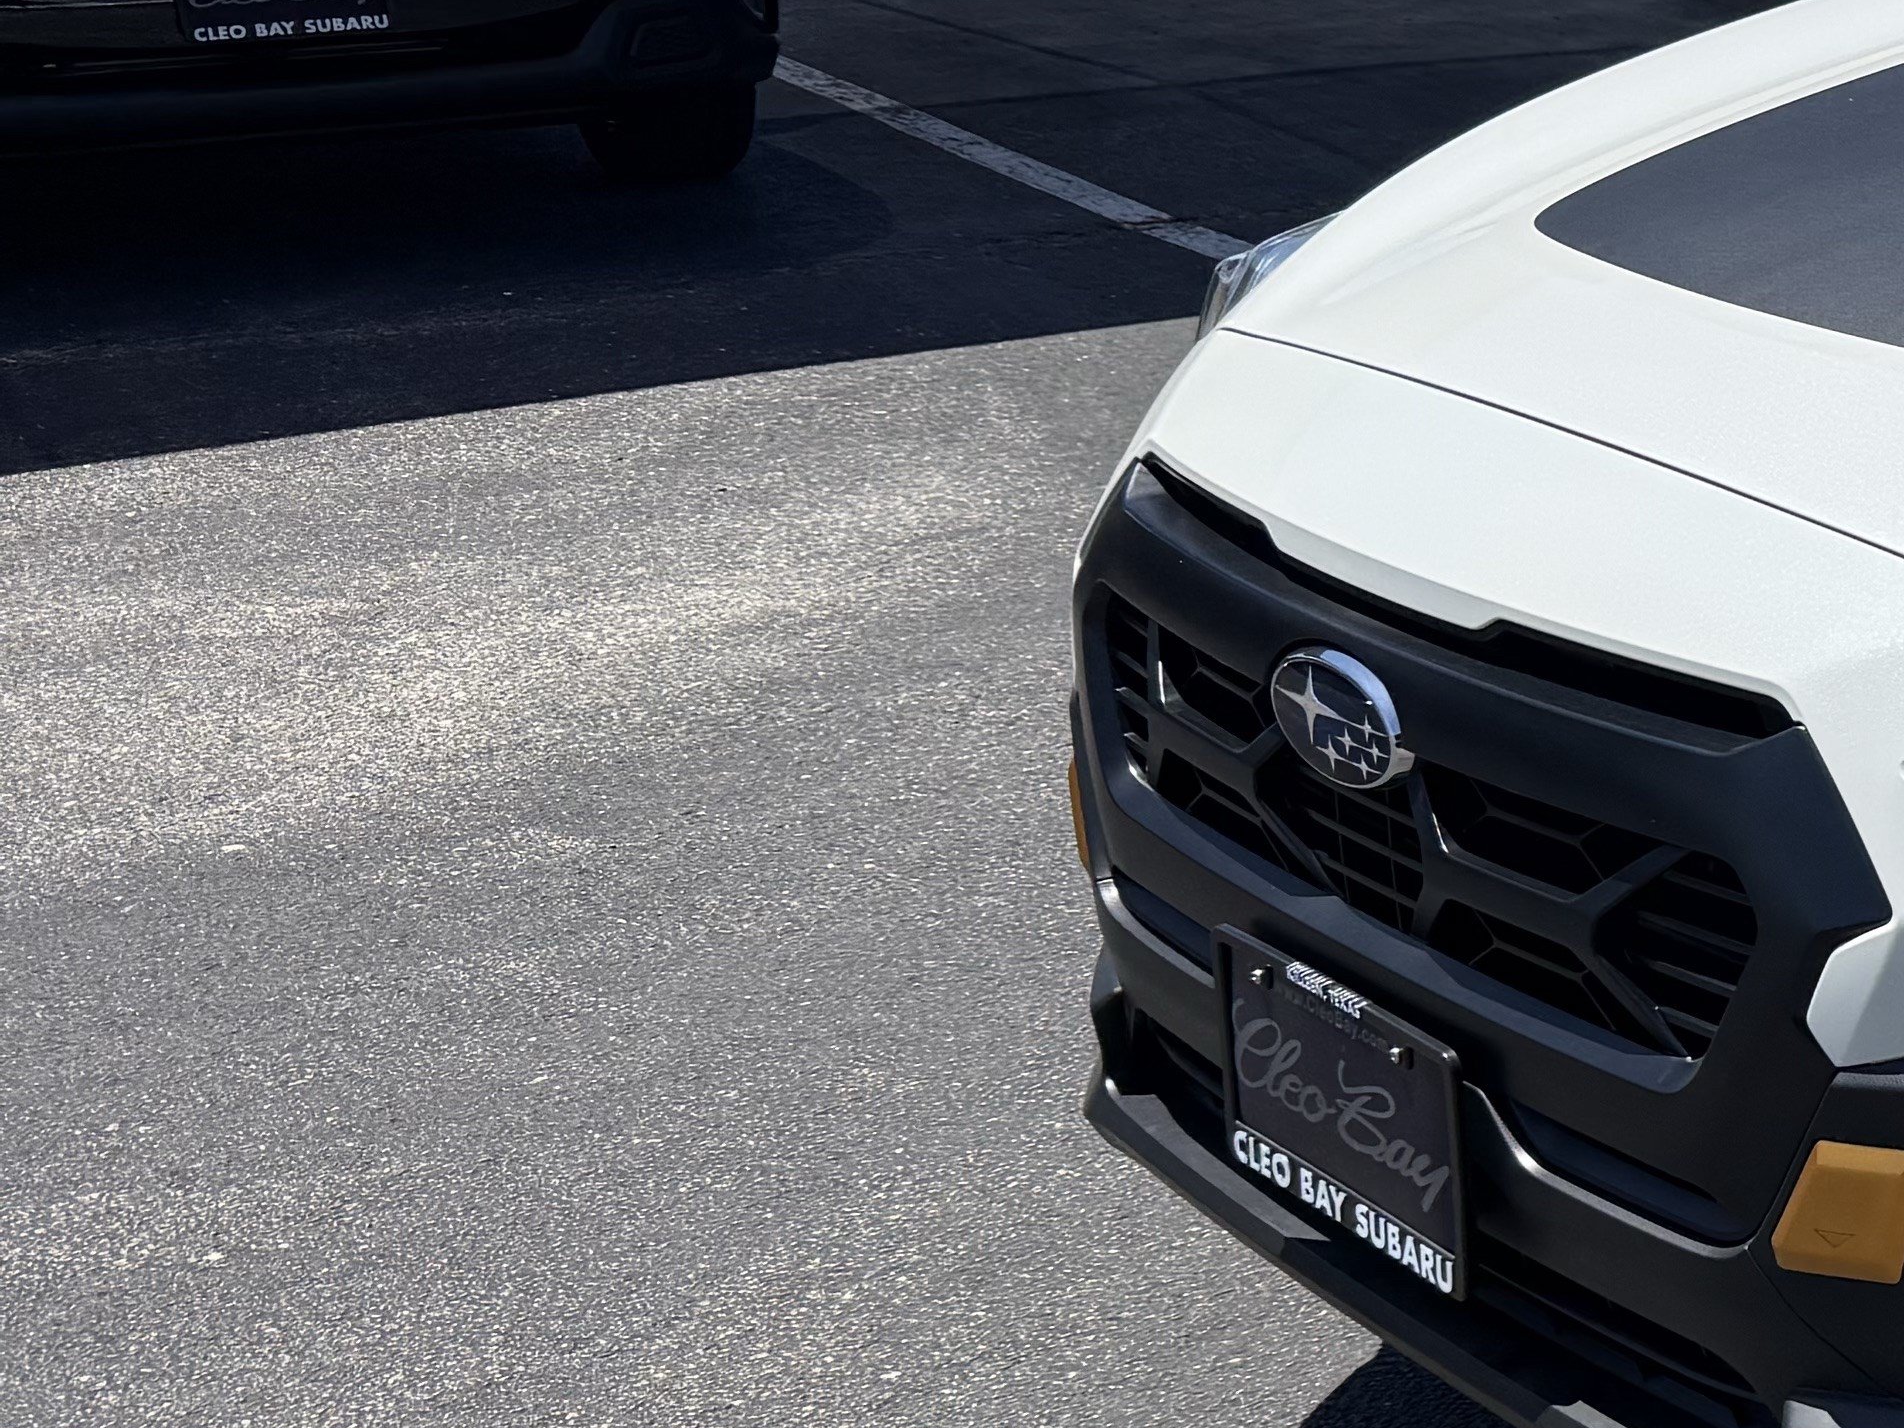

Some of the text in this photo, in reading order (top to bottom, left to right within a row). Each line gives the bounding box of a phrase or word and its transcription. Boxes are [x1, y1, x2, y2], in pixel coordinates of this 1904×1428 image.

[194, 13, 390, 42] CLEO BAY SUBARU
[1232, 997, 1450, 1213] Cleo Bay
[1233, 1130, 1455, 1295] CLEO BAY SUBARU
